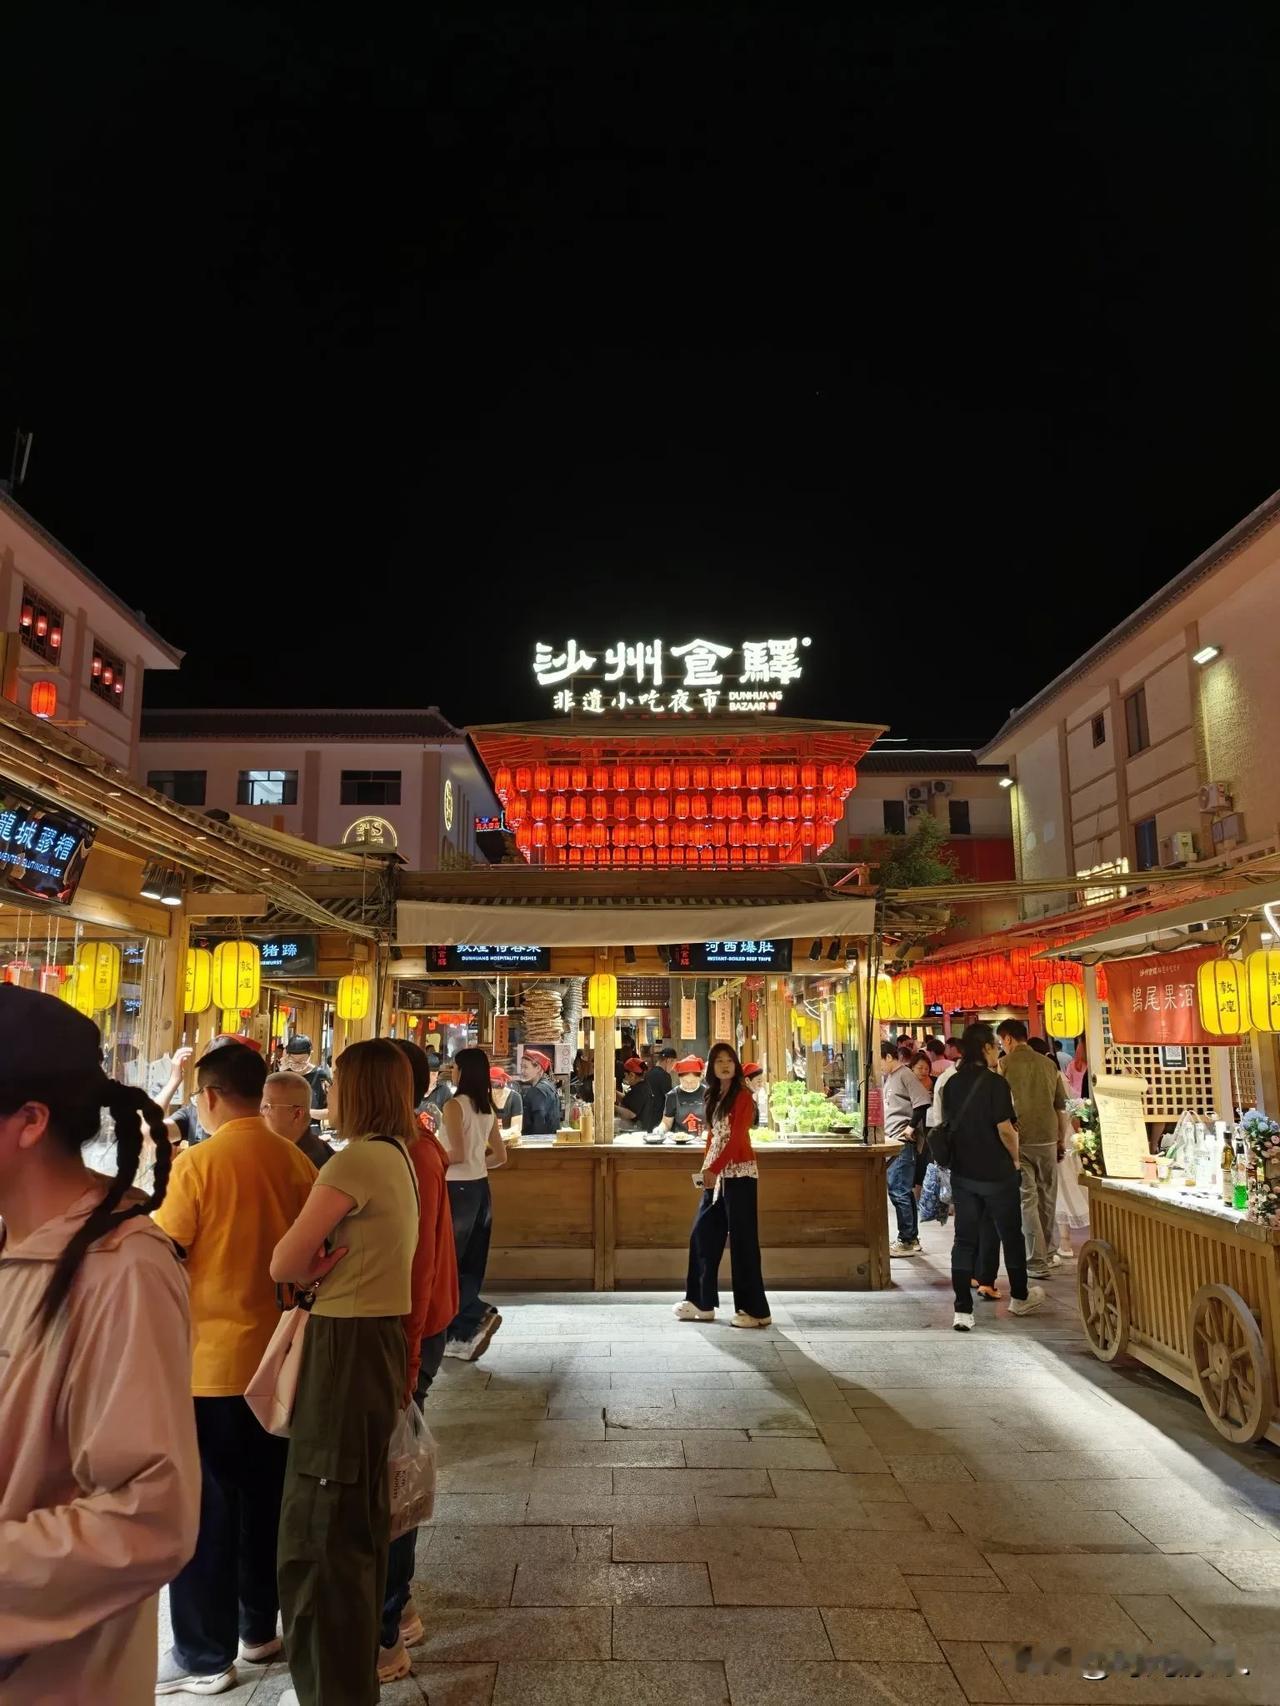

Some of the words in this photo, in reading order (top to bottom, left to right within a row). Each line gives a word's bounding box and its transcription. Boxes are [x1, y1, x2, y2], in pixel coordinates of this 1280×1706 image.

[729, 691, 783, 701] DUNHUANG
[729, 702, 766, 711] BAZAAR
[257, 943, 298, 957] 猪蹄
[1218, 981, 1237, 1012] 敦煌
